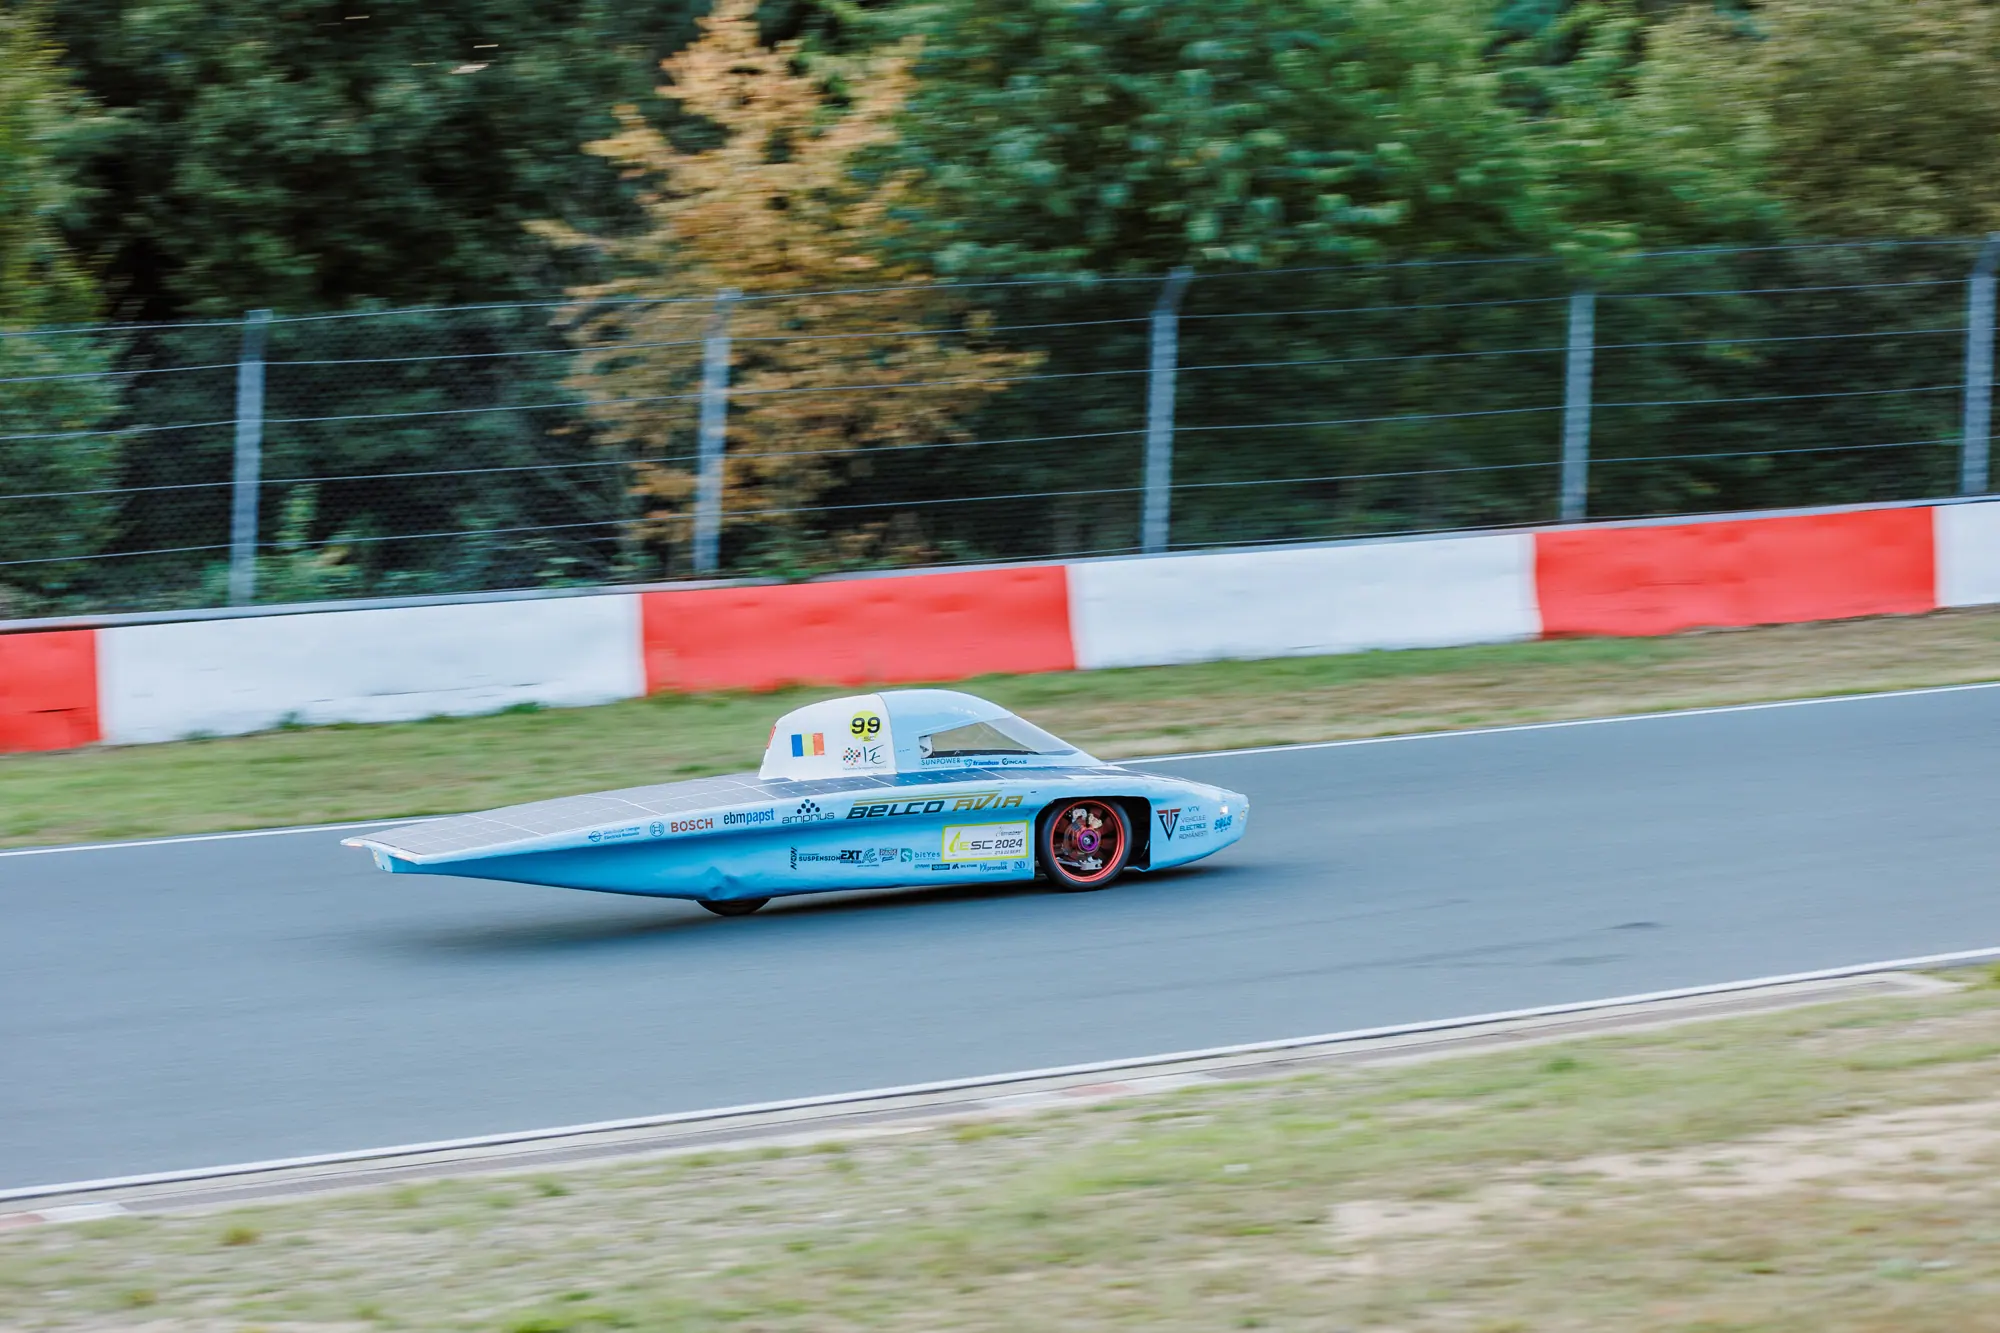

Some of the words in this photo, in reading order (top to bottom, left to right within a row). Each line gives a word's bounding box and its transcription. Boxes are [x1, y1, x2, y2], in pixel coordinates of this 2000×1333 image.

[851, 716, 881, 734] 99
[921, 757, 961, 766] SUNPOWER
[723, 808, 775, 825] ebmpapst
[781, 811, 835, 825] amprius
[671, 818, 714, 833] BOSCH
[994, 838, 1023, 849] 2024
[840, 849, 863, 861] EXT
[914, 851, 940, 860] bitYes
